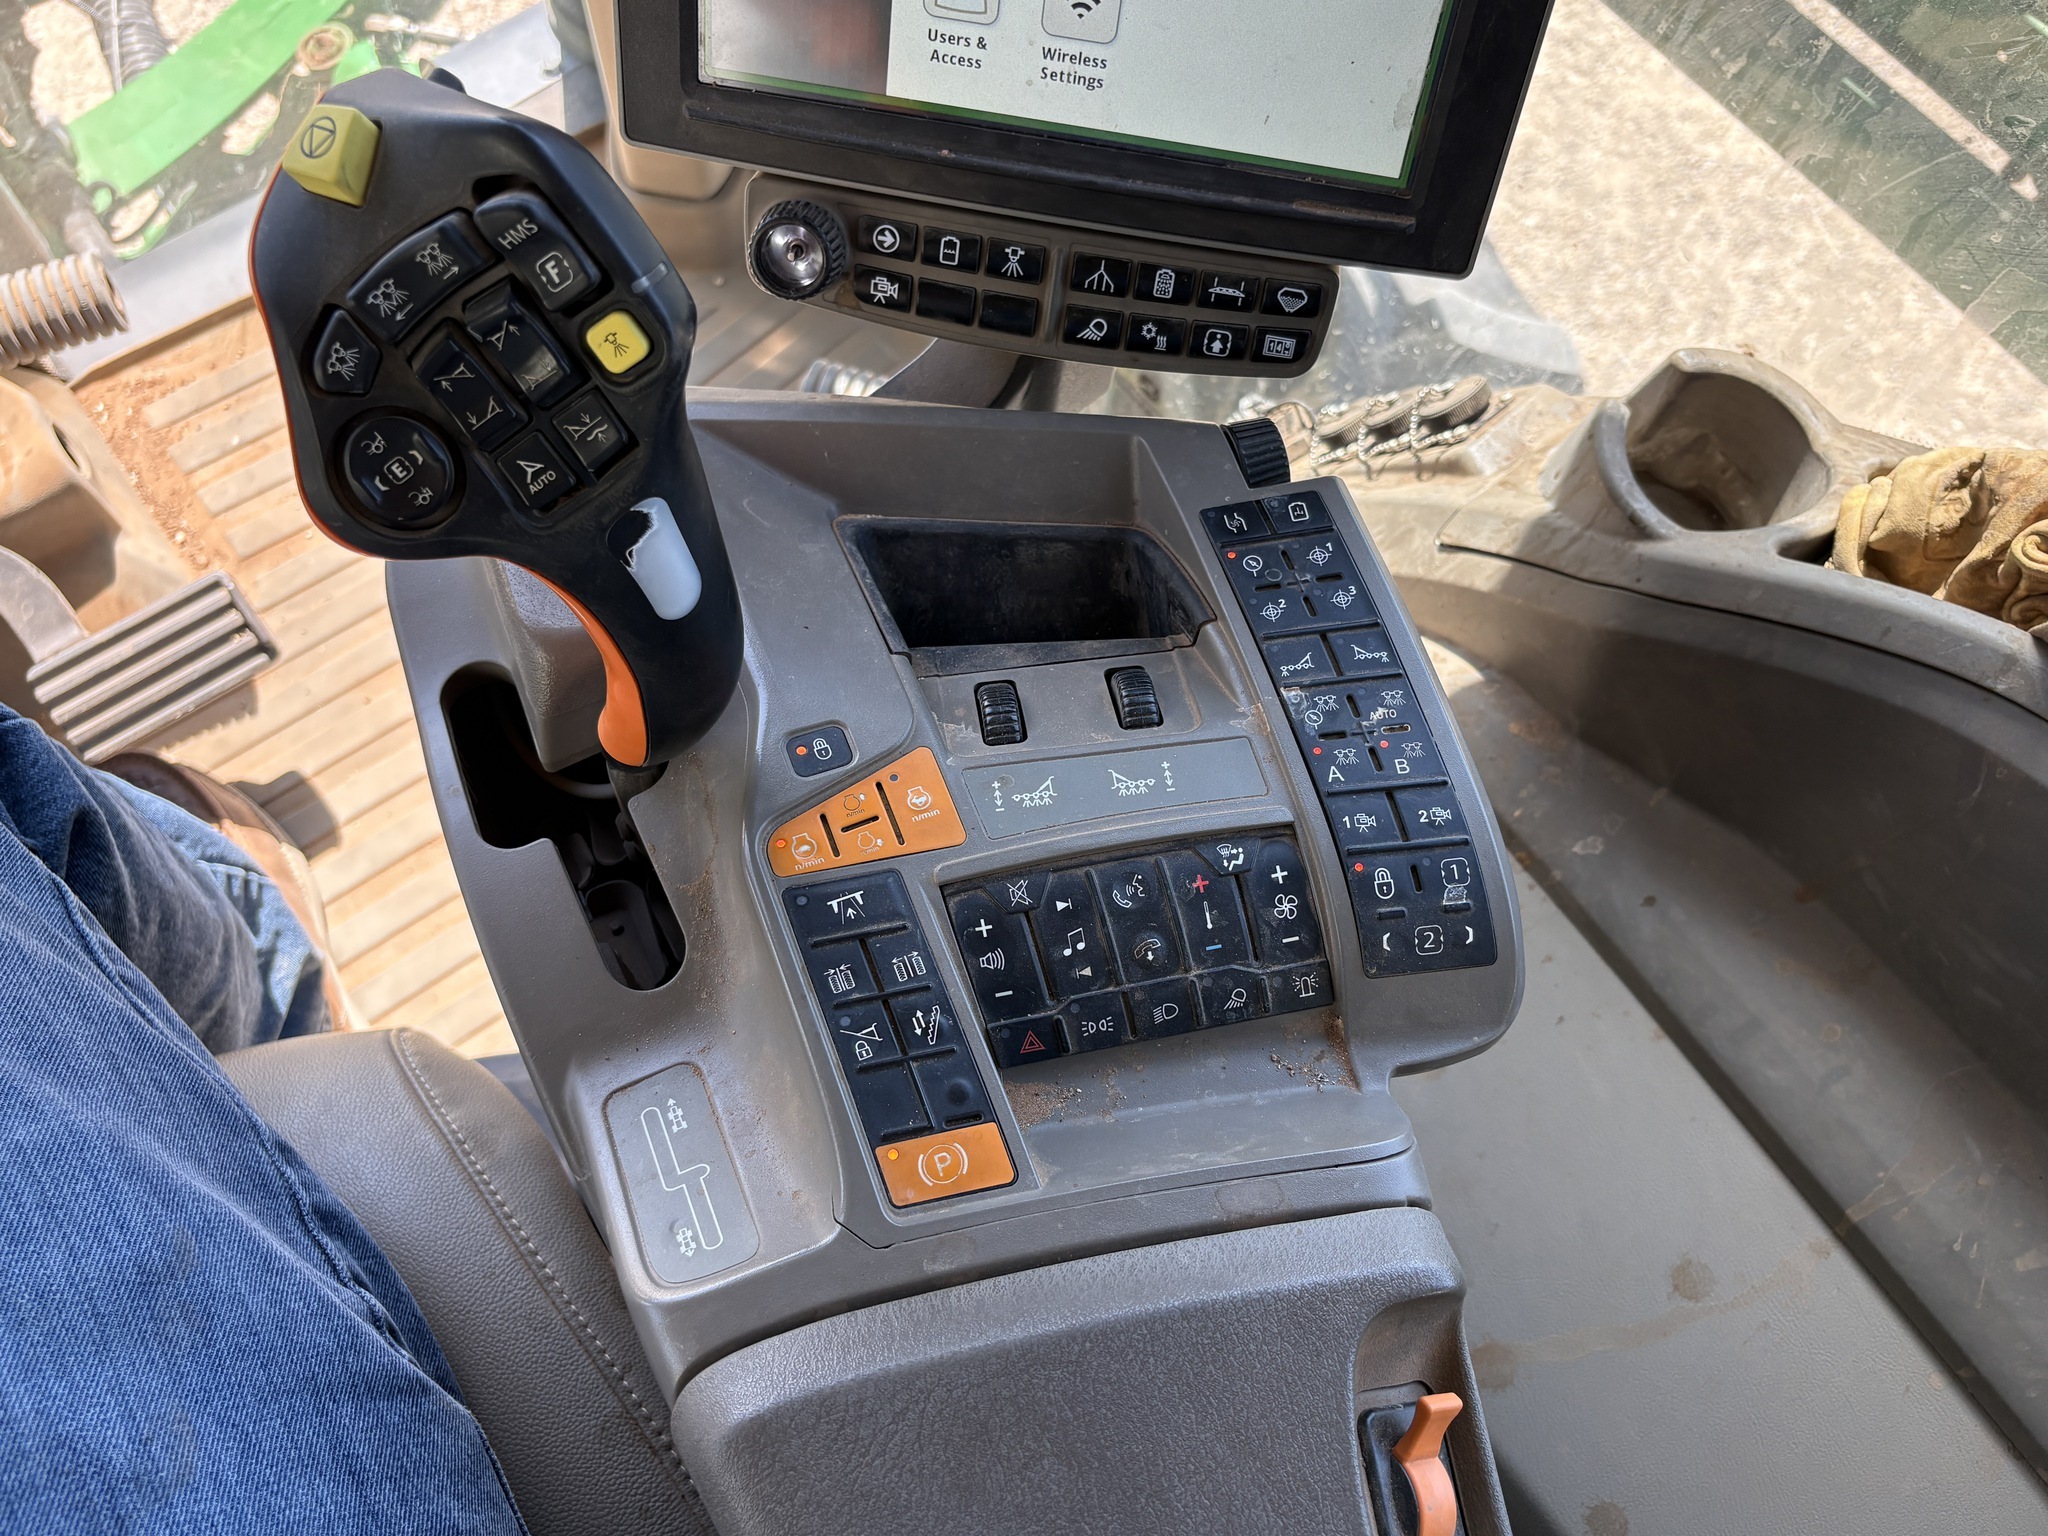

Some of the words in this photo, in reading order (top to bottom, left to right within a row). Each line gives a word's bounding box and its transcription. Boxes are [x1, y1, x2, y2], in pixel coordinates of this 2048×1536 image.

[927, 28, 972, 48] Users
[976, 36, 988, 51] &
[930, 49, 982, 69] Access
[1042, 46, 1108, 70] Wireless
[1040, 66, 1104, 91] Settings
[498, 217, 539, 250] HMS
[544, 260, 561, 284] F
[390, 462, 408, 478] E
[529, 470, 557, 496] AUTO
[1325, 542, 1333, 552] 1
[1347, 585, 1357, 595] 3
[1277, 598, 1287, 608] 2
[1369, 708, 1397, 720] AUTO
[1328, 765, 1345, 783] A
[1394, 758, 1410, 775] B
[911, 808, 941, 823] n/min
[1342, 815, 1351, 829] 1
[1418, 809, 1429, 823] 2
[794, 856, 826, 871] n/min
[1449, 863, 1459, 880] 1
[1423, 931, 1436, 948] 2
[933, 1151, 952, 1177] P
